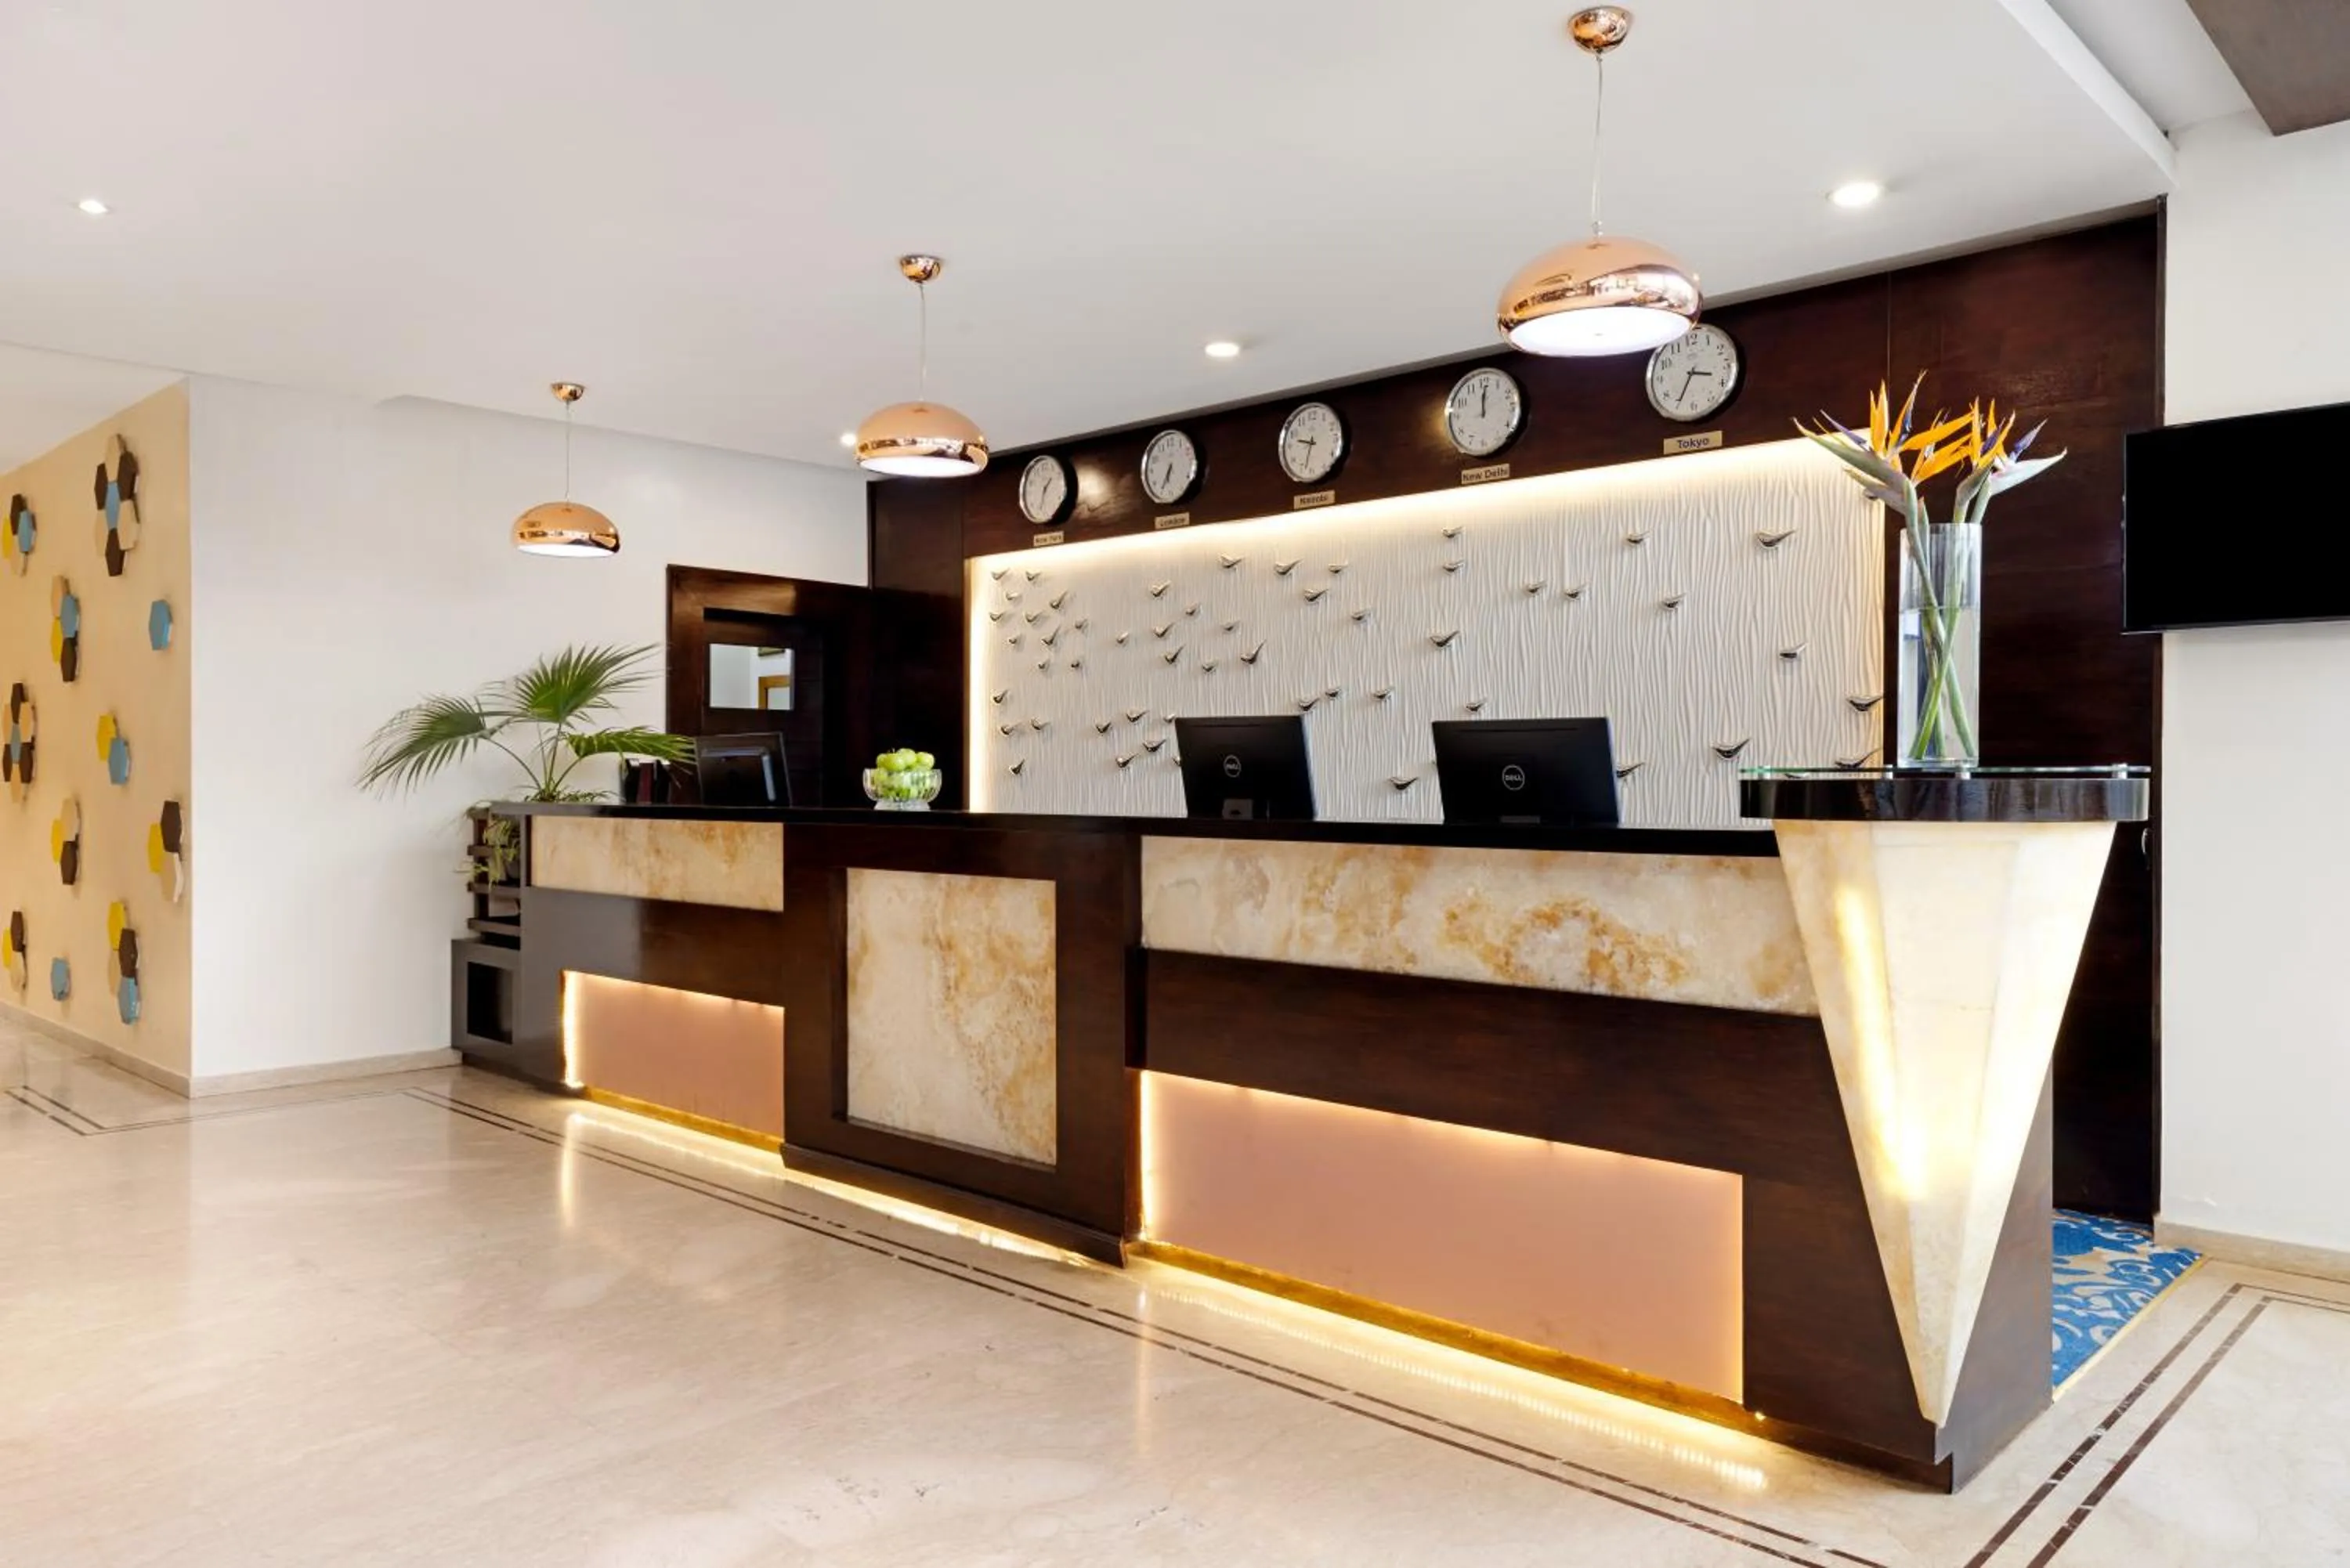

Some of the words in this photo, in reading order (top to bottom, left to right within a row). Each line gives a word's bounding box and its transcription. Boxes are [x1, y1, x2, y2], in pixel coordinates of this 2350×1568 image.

[1686, 333, 1697, 346] 12
[1671, 342, 1680, 354] 11
[1716, 344, 1724, 356] 2
[1661, 357, 1672, 370] 10
[1467, 383, 1475, 395] 11
[1677, 439, 1709, 449] Tokyo
[1462, 471, 1481, 481] New
